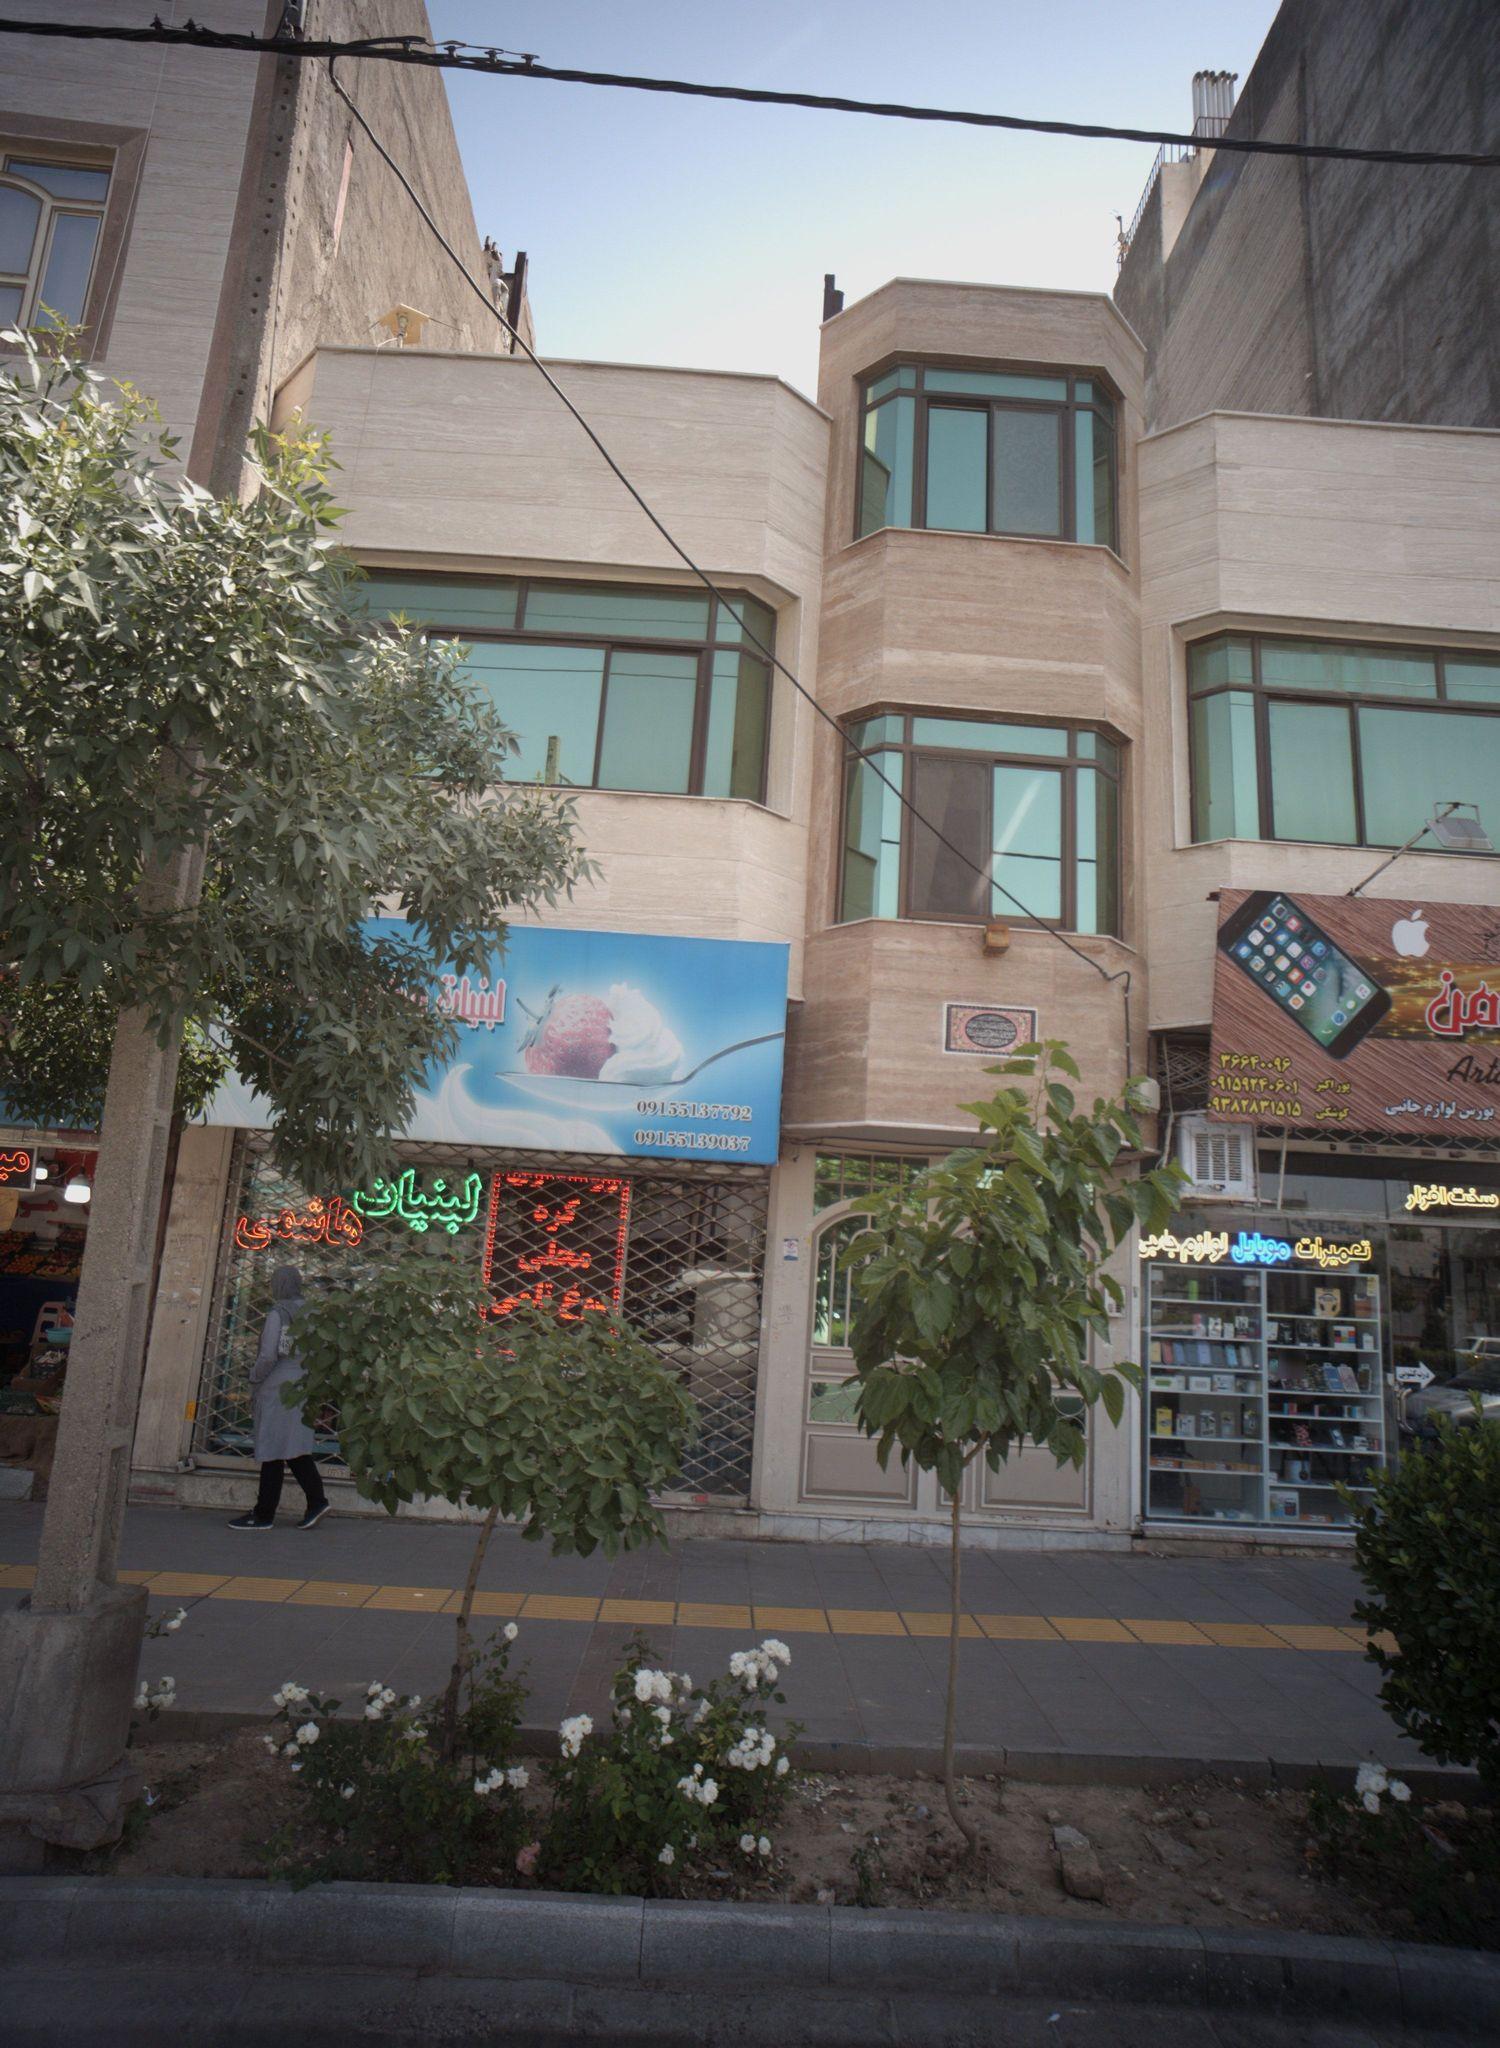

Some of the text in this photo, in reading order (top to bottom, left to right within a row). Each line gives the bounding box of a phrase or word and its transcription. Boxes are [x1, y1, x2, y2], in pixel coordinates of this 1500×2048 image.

[1220, 1053, 1292, 1072] ۳۶۶۴۰۰۹۶
[1210, 1075, 1298, 1094] ۰۹۱۵۹۲۴۰۶۰۱
[636, 1100, 752, 1121] 09155137792
[1207, 1097, 1301, 1117] ۰۹۳۸۲۸۳۱۵۱۵
[1384, 1098, 1495, 1121] بورس لوازم جانبی
[635, 1128, 752, 1152] 09155139037
[353, 1168, 483, 1236] لبنیات
[1404, 1184, 1500, 1211] سخت افزار
[1179, 1230, 1229, 1264] لوازم
[1230, 1231, 1292, 1264] موبایل
[1296, 1237, 1372, 1267] تعمیرات
